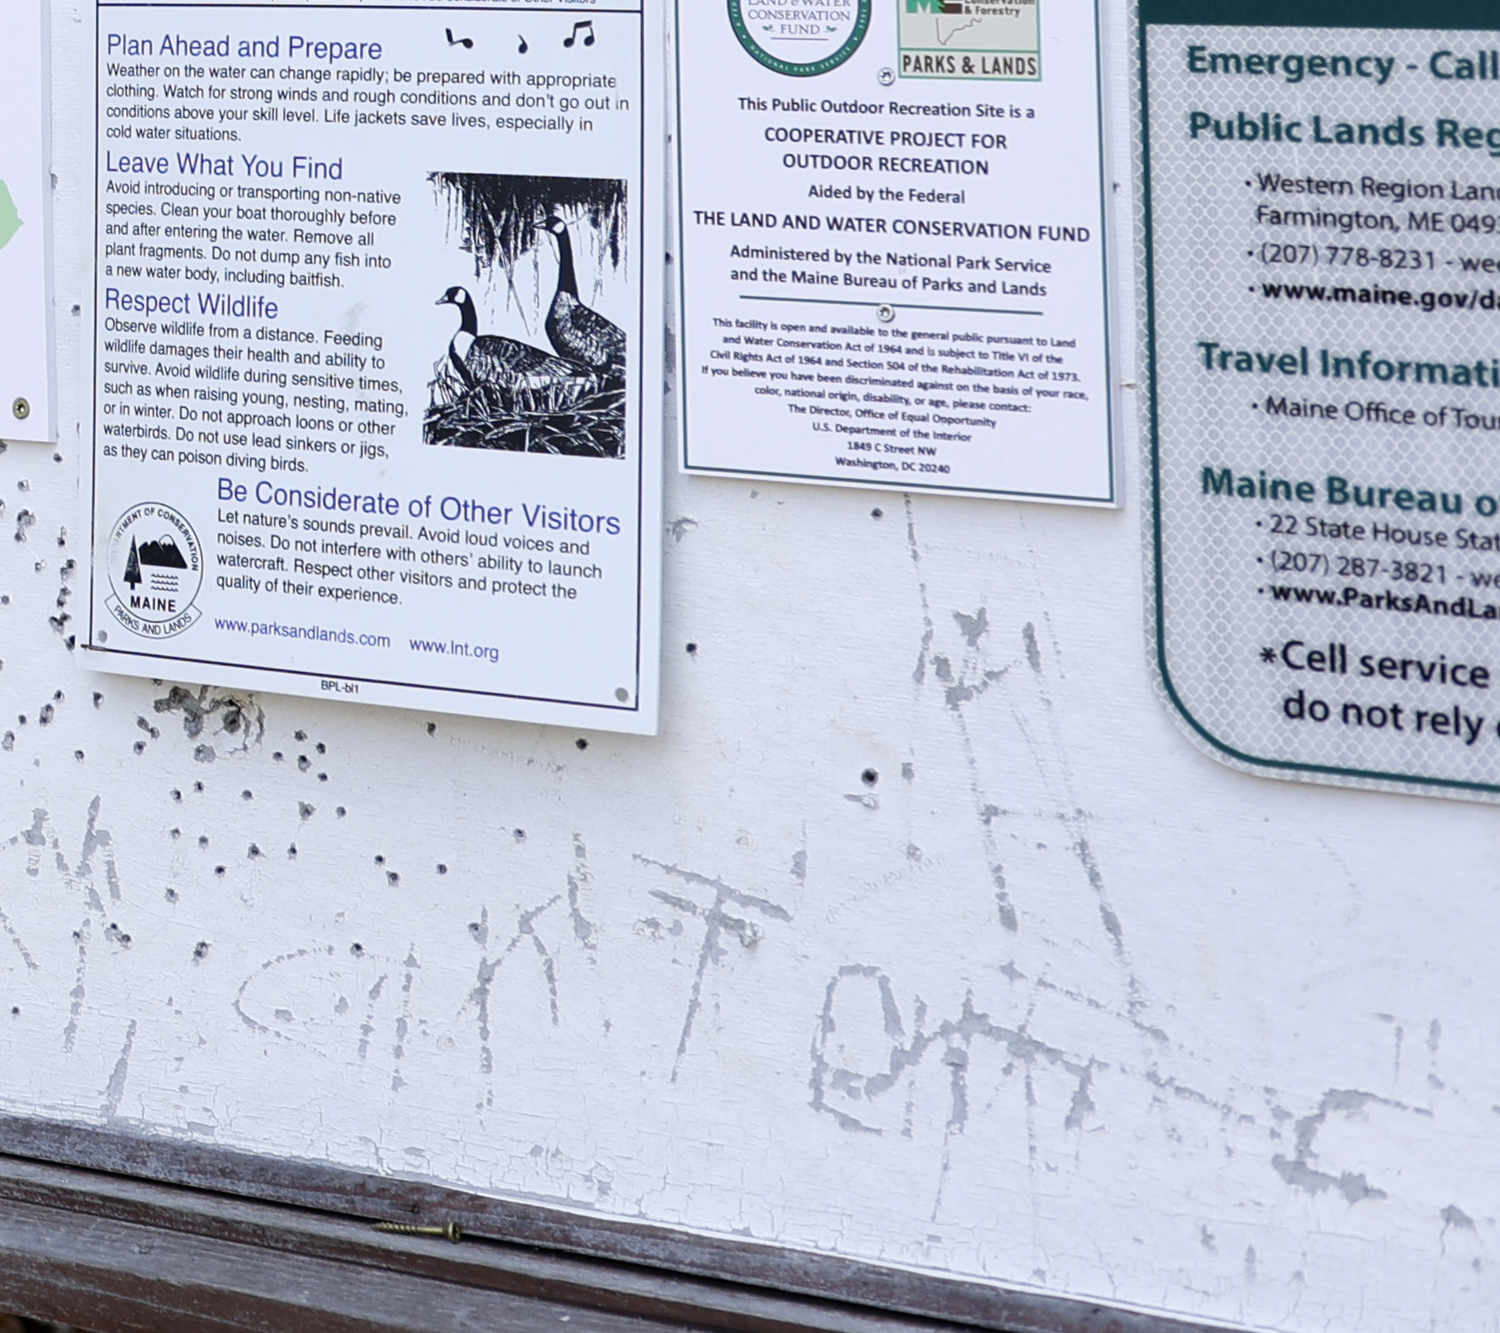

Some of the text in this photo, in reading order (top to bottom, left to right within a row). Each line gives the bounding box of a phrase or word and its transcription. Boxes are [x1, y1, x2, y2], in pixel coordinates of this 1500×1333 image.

[748, 10, 850, 21] CONSERVATION
[780, 24, 820, 34] FUND
[108, 34, 382, 64] Plan Ahead and Prepare
[903, 55, 1036, 75] PARKS & LANDS
[1187, 45, 1395, 85] Emergency
[765, 127, 1007, 149] COOPERATIVE PROJECT FOR
[1190, 112, 1302, 143] Public
[1313, 115, 1425, 146] Lands
[107, 150, 342, 180] Leave What You Find
[783, 154, 988, 175] OUTDOOR RECREATION
[106, 180, 401, 204] Avoid introducing or transporting non-native
[693, 211, 1090, 242] THE LAND AND WATER CONSERVATION FUND
[1261, 243, 1434, 270] (207) 778-8231
[106, 288, 278, 319] Respect Wildlife
[1197, 341, 1308, 375] Travel
[1202, 467, 1462, 514] Maine Bureau
[218, 478, 620, 535] Be Considerate of Other Visitors
[131, 595, 175, 612] MAINE
[215, 619, 498, 663] www.parksandlands.com www.lnt.org
[1360, 655, 1490, 689] service
[1283, 689, 1484, 746] do not rely
